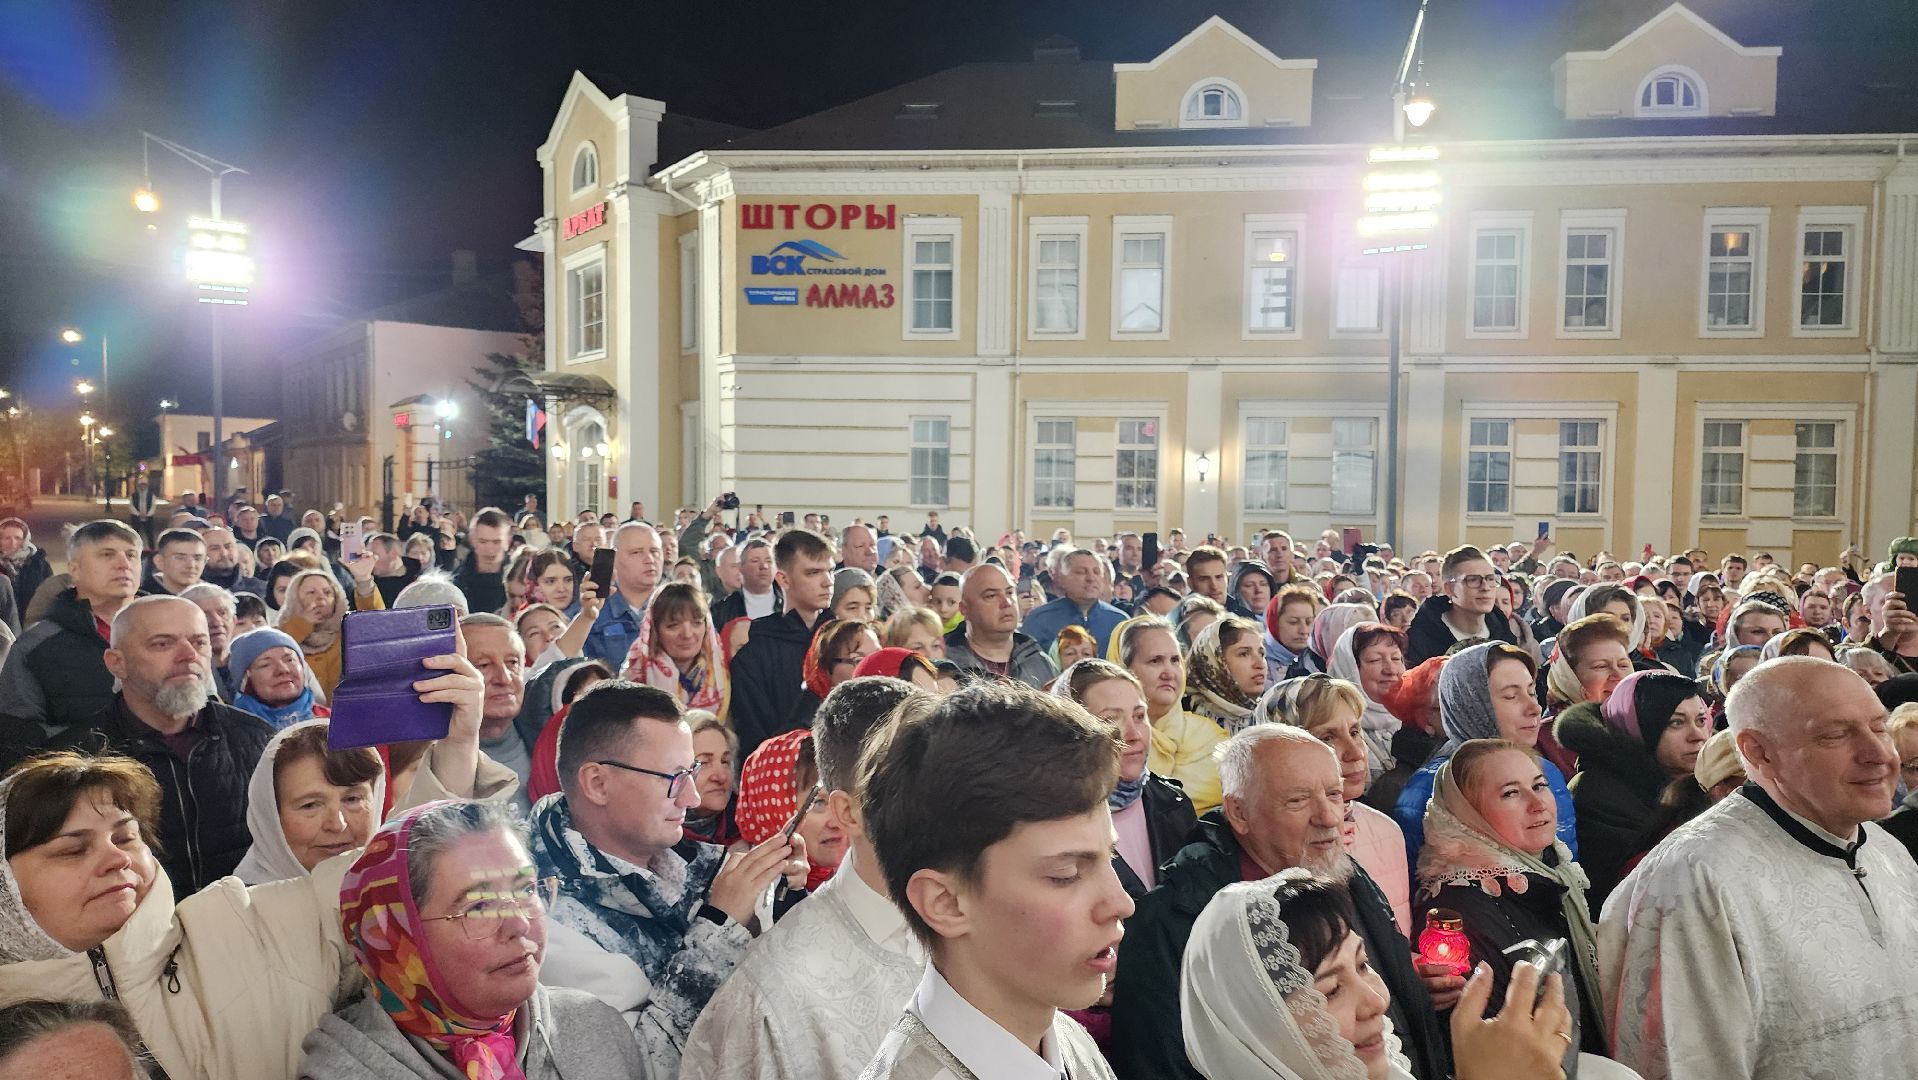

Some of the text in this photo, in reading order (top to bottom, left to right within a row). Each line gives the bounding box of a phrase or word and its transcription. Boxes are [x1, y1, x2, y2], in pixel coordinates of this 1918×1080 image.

[741, 203, 896, 230] ШТОРЫ
[751, 255, 806, 276] ВСК
[806, 266, 886, 277] СТРАХОВОЙ ДОМ
[805, 283, 895, 309] АЛМАЗ
